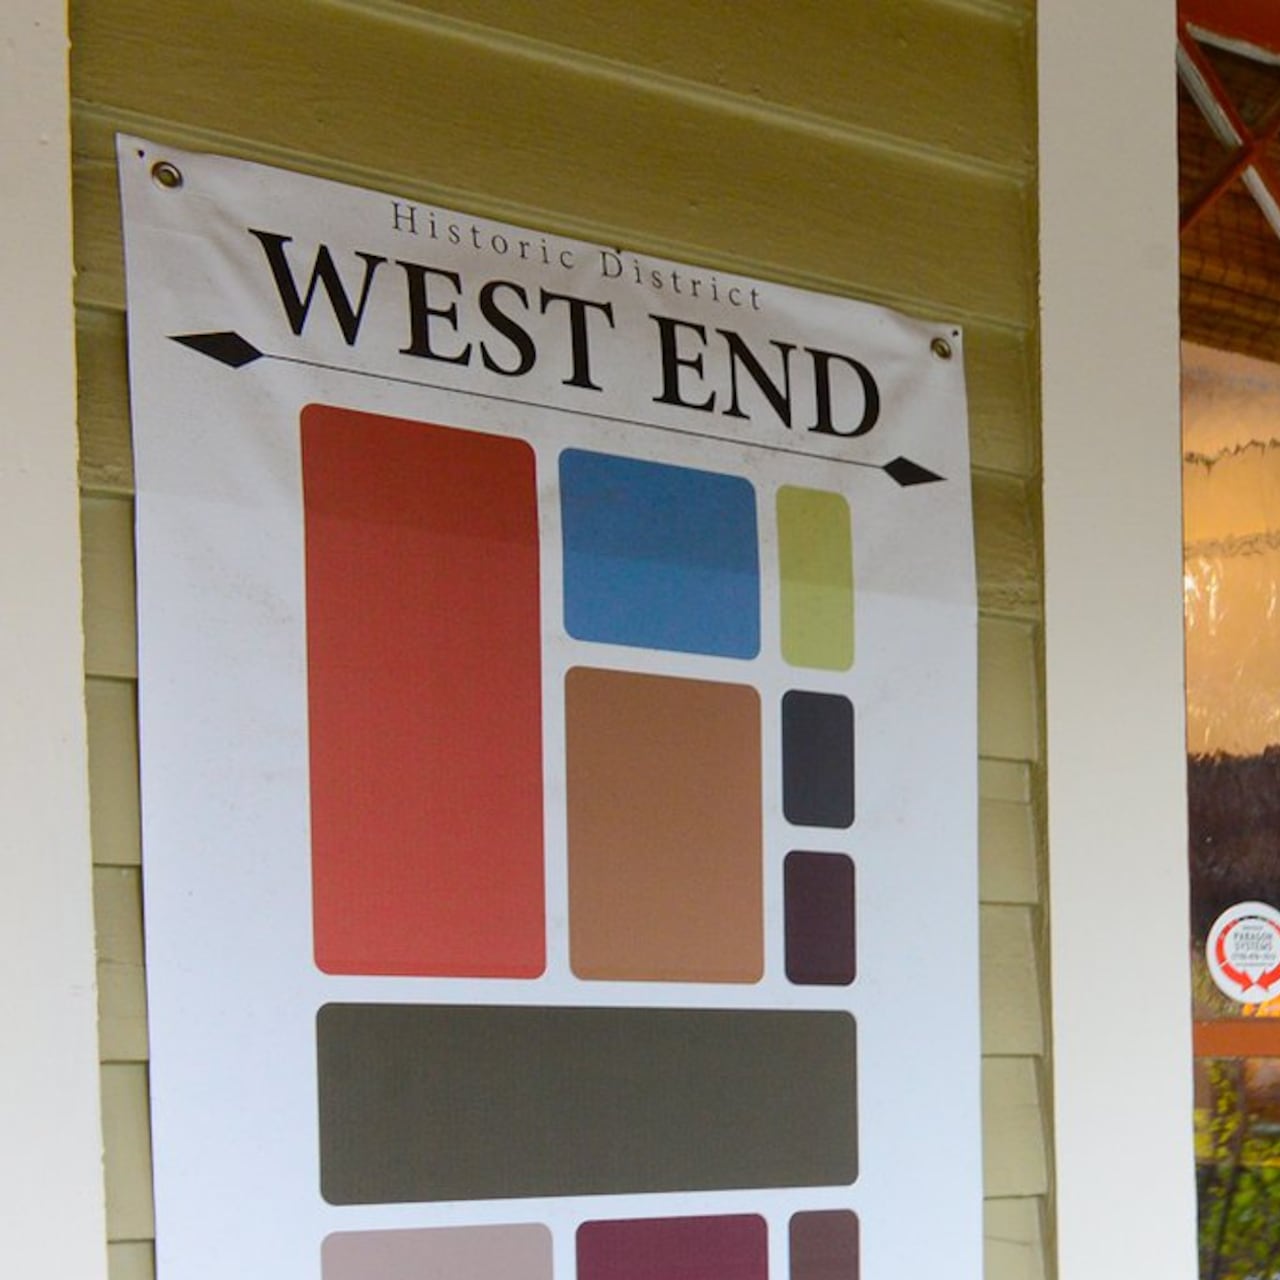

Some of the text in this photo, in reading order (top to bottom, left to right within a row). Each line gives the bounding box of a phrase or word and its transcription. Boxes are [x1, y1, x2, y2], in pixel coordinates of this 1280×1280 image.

[247, 228, 880, 438] WEST END
[391, 202, 763, 311] Historic District
